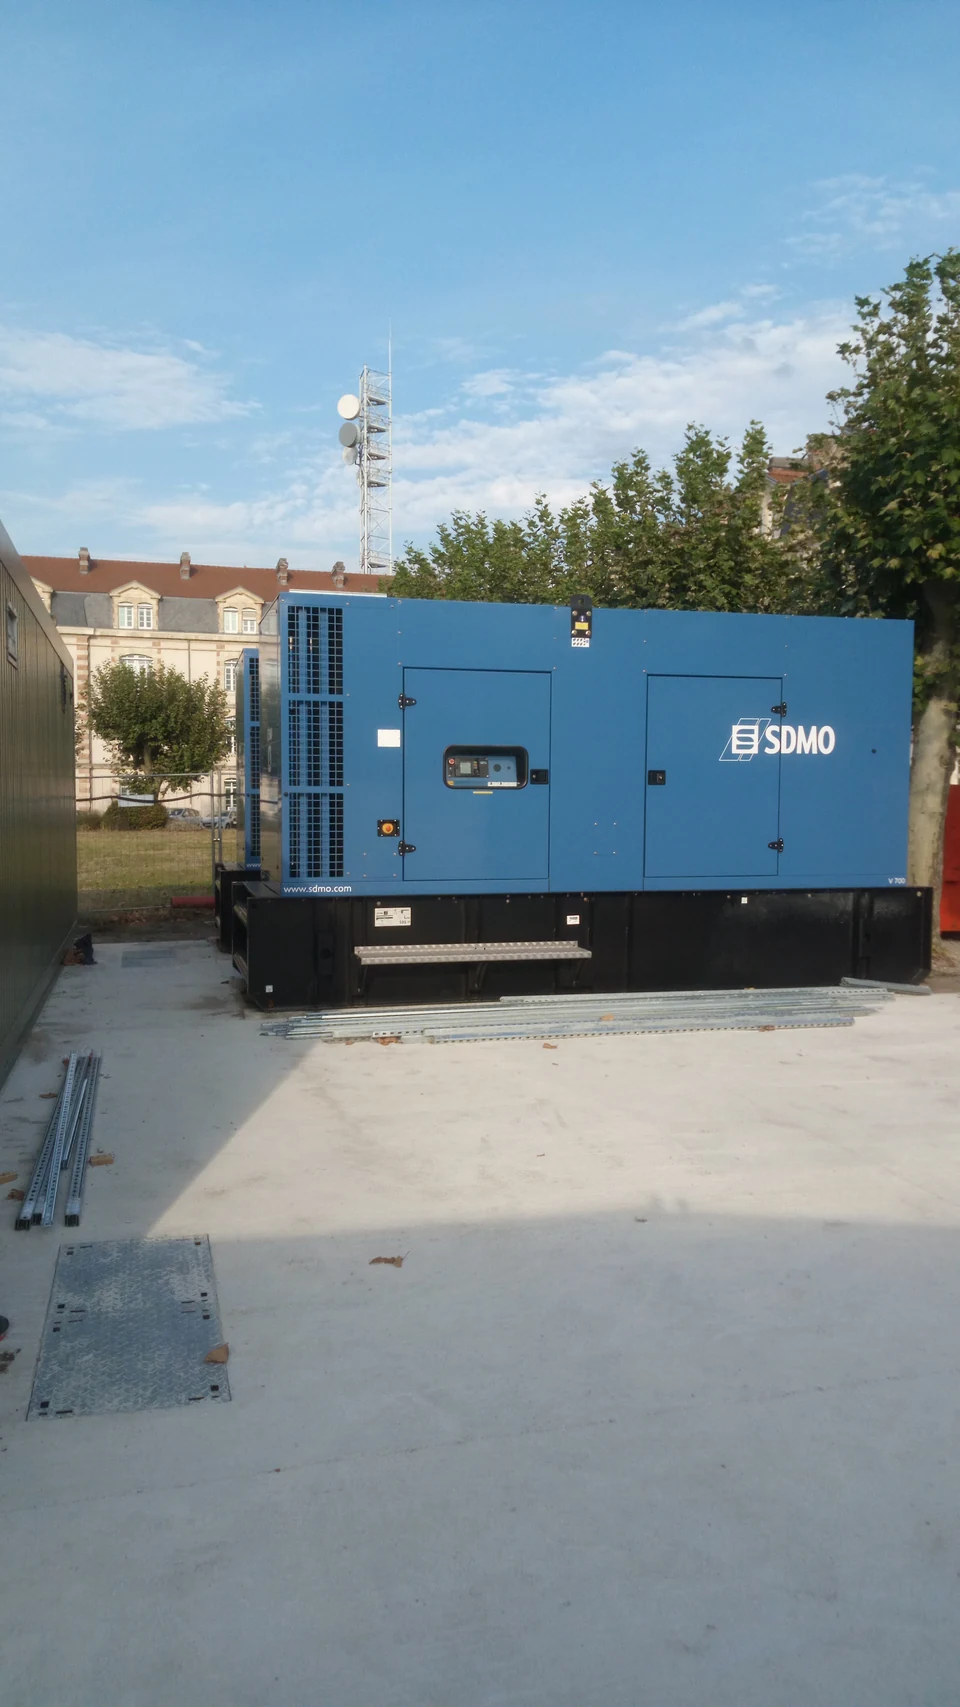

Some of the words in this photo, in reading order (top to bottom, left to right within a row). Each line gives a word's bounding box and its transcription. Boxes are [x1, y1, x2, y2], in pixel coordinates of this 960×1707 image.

[764, 725, 836, 755] SDMO
[887, 877, 894, 885] V
[894, 877, 906, 885] 700
[283, 884, 352, 893] www.sdmo.com
